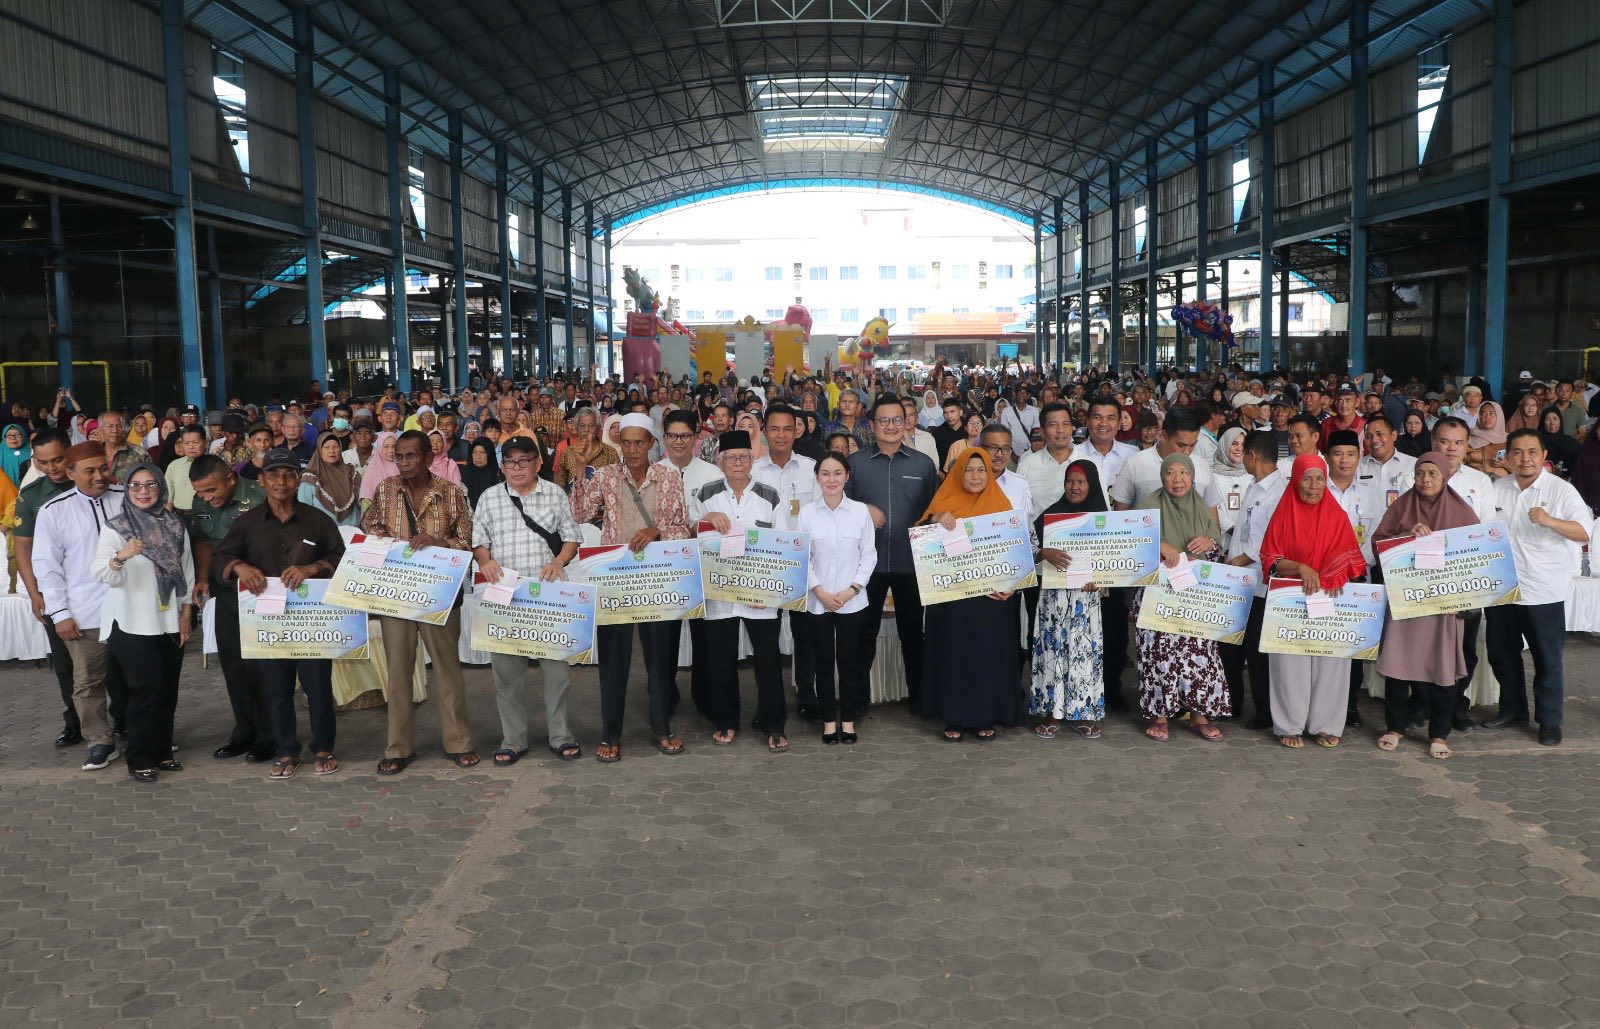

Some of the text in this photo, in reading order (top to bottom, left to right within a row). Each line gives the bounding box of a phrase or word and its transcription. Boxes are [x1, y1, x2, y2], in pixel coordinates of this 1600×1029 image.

[971, 544, 998, 552] ANTUAN
[1000, 539, 1023, 547] SOSIAL
[935, 547, 1010, 565] KEPADA MASYARAKAT
[1445, 557, 1476, 566] ANTUAN
[1478, 552, 1505, 562] SOSIAL
[742, 562, 787, 571] MASYARAKAT
[1406, 569, 1436, 578] KEPADA
[358, 568, 437, 584] KEPADA MASYARAKAT
[374, 576, 400, 584] LANJUT
[394, 568, 453, 582] BANTUAN SOSIAL
[589, 573, 635, 582] PENYERAHAN
[932, 562, 1020, 589] Rp.300.000,-
[1426, 573, 1453, 582] LANJUT
[710, 572, 793, 594] Rp.300.000,-
[1404, 577, 1502, 603] Rp.300.000,-
[344, 580, 436, 607] Rp.300.000,-
[600, 591, 689, 611] Rp.300.000,-
[1165, 589, 1232, 605] KEPADA MASYARAKAT
[1195, 589, 1246, 602] BANTUAN SOSIAL
[480, 602, 526, 612] PENYERAHAN
[528, 607, 560, 616] BANTUAN
[1179, 598, 1202, 606] LANJUT
[494, 610, 572, 624] KEPADA MASYARAKAT
[1155, 603, 1234, 628] Rp.300.000,-
[258, 630, 352, 646] Rp.300.000,-
[488, 624, 578, 647] Rp.300.000,-
[1278, 627, 1365, 645] Rp.300.000,-
